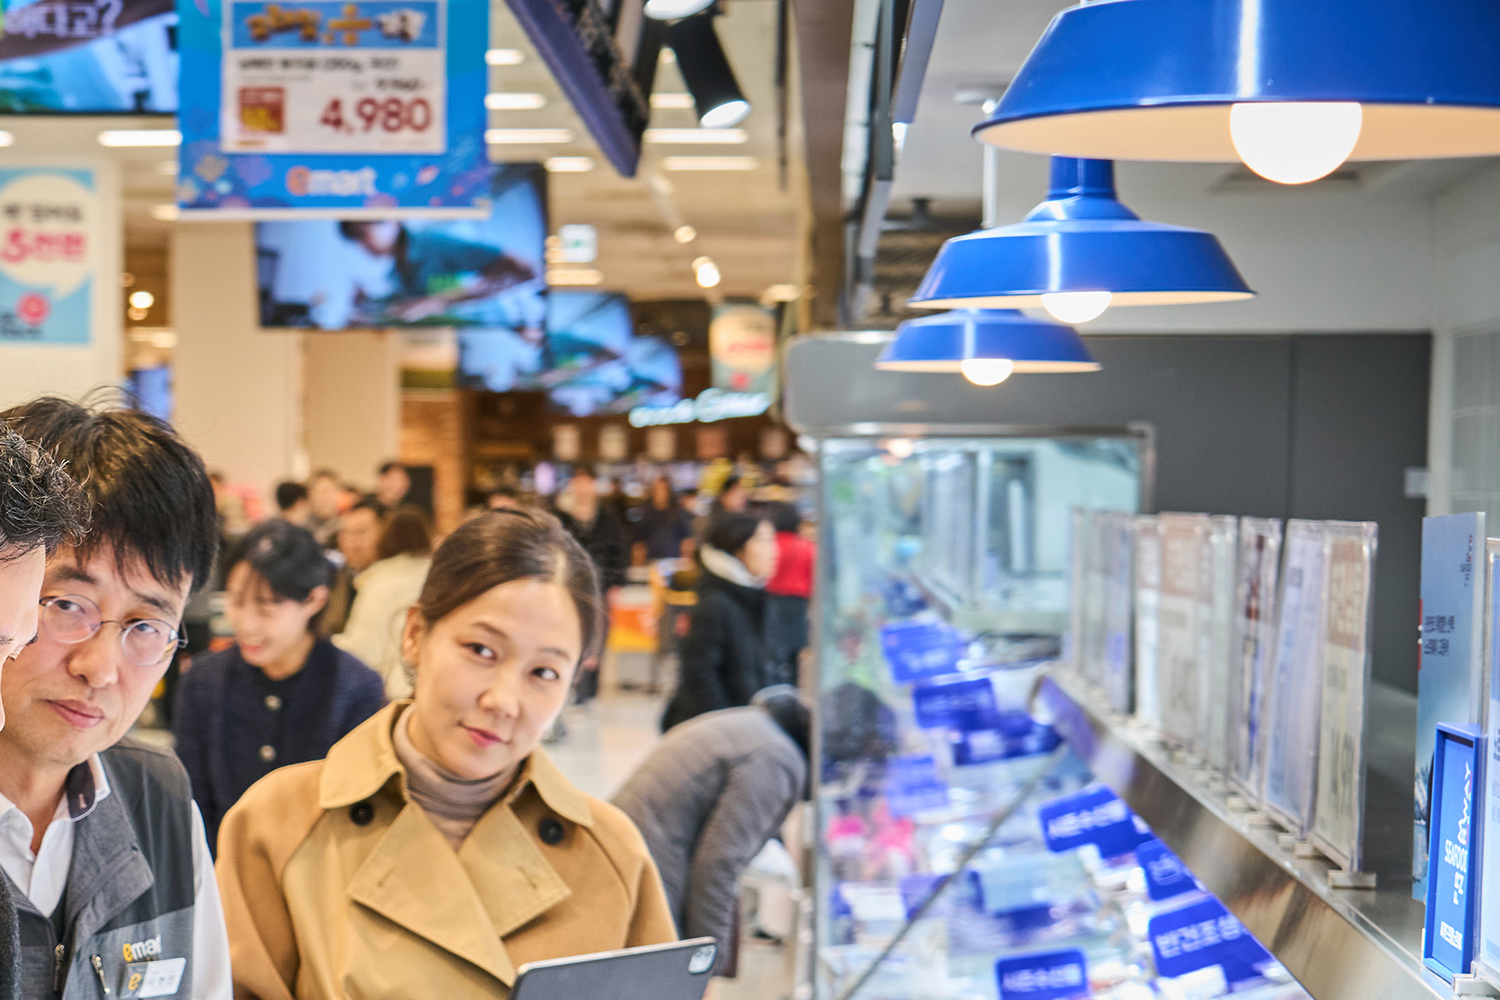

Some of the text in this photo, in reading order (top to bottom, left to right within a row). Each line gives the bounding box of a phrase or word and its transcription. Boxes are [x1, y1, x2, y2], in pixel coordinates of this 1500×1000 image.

[320, 97, 432, 135] 4,980
[286, 165, 377, 196] emart
[1155, 912, 1245, 958] 반건조생
